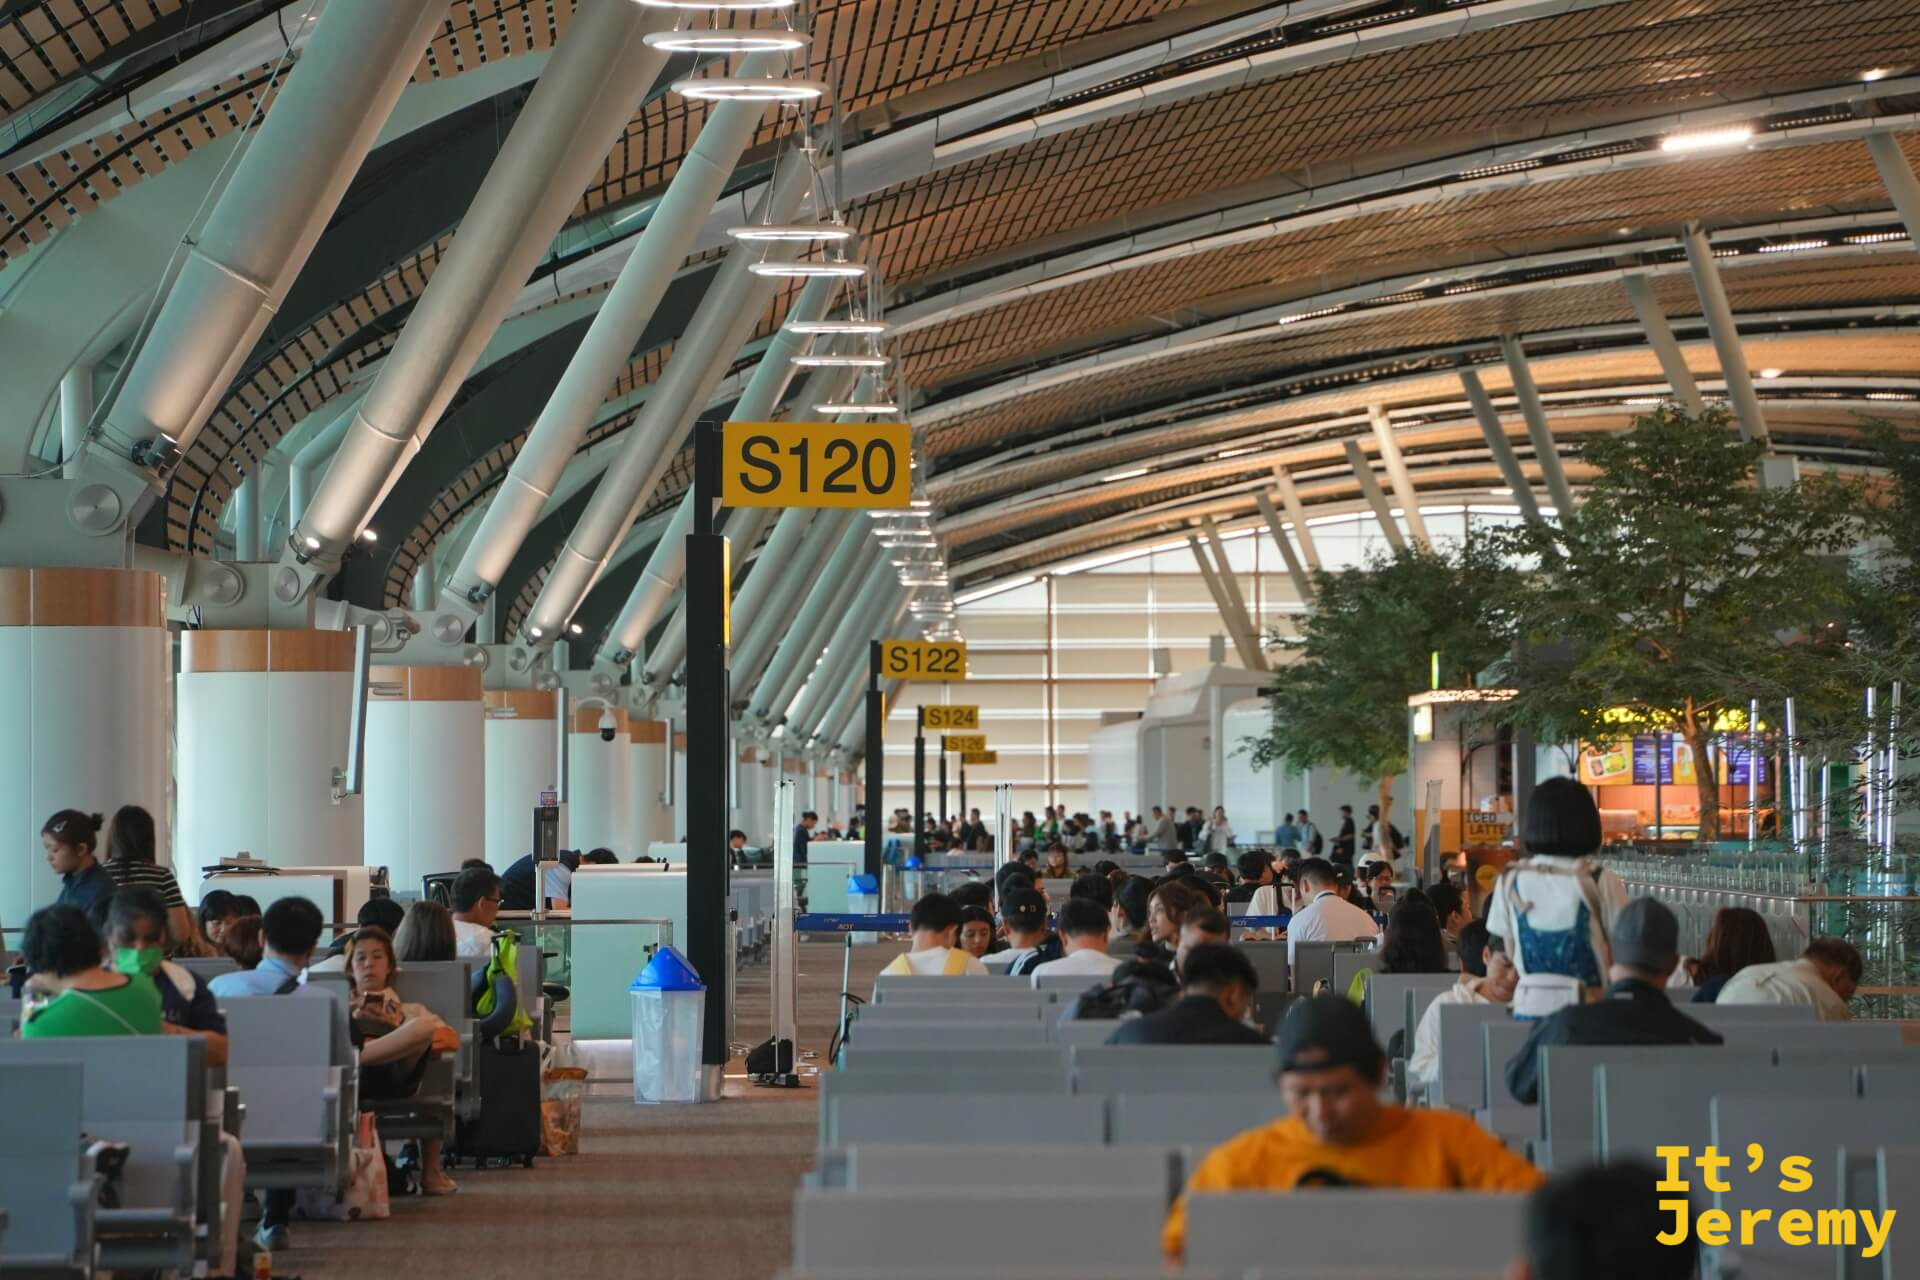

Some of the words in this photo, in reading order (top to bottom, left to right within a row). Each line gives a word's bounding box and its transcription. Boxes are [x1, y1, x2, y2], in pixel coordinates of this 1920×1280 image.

[739, 435, 896, 495] S120
[889, 646, 960, 673] S122
[929, 708, 975, 726] S124
[1466, 812, 1497, 823] ICED
[1471, 824, 1507, 835] LATTE
